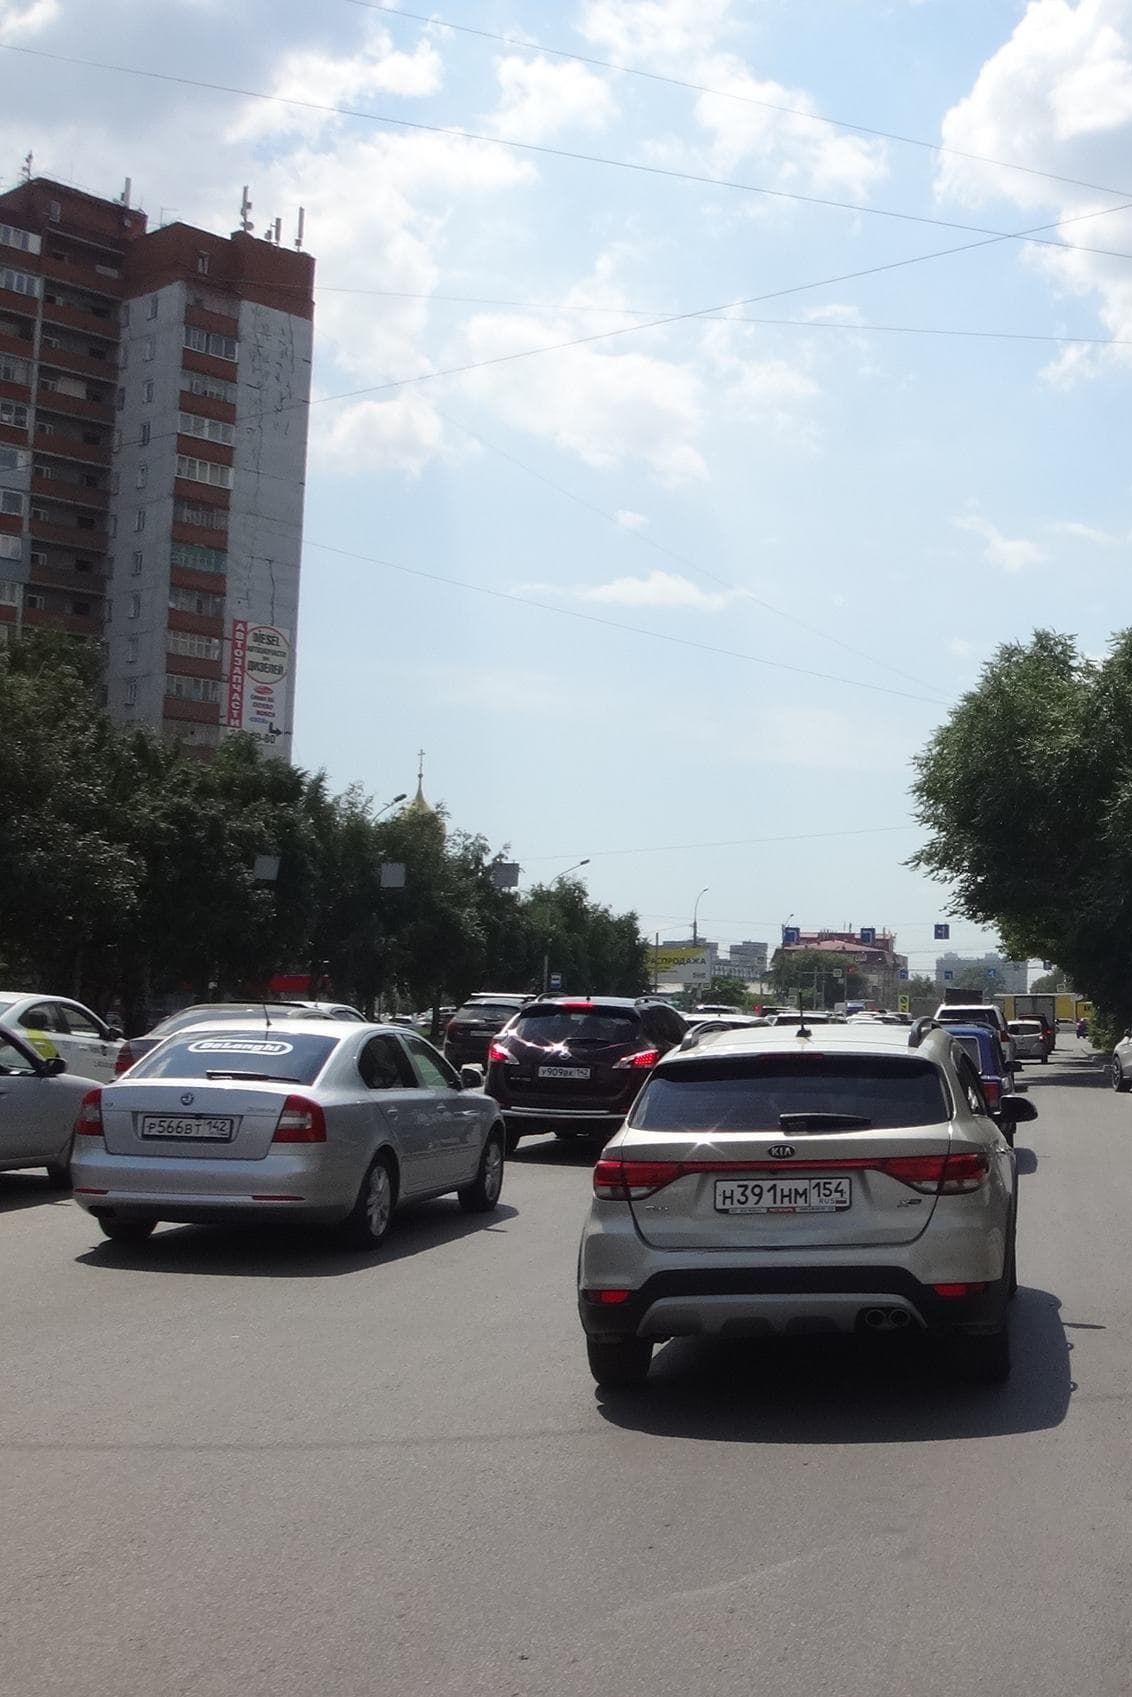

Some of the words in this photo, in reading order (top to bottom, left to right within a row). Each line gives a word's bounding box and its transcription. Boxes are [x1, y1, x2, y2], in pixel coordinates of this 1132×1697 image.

[230, 623, 246, 727] АВТОЗАПЧАСТИ
[146, 1119, 201, 1134] Р566ВТ
[206, 1120, 228, 1133] 142
[771, 1147, 792, 1156] KIA
[722, 1184, 808, 1206] Н391НМ
[812, 1181, 844, 1198] 154
